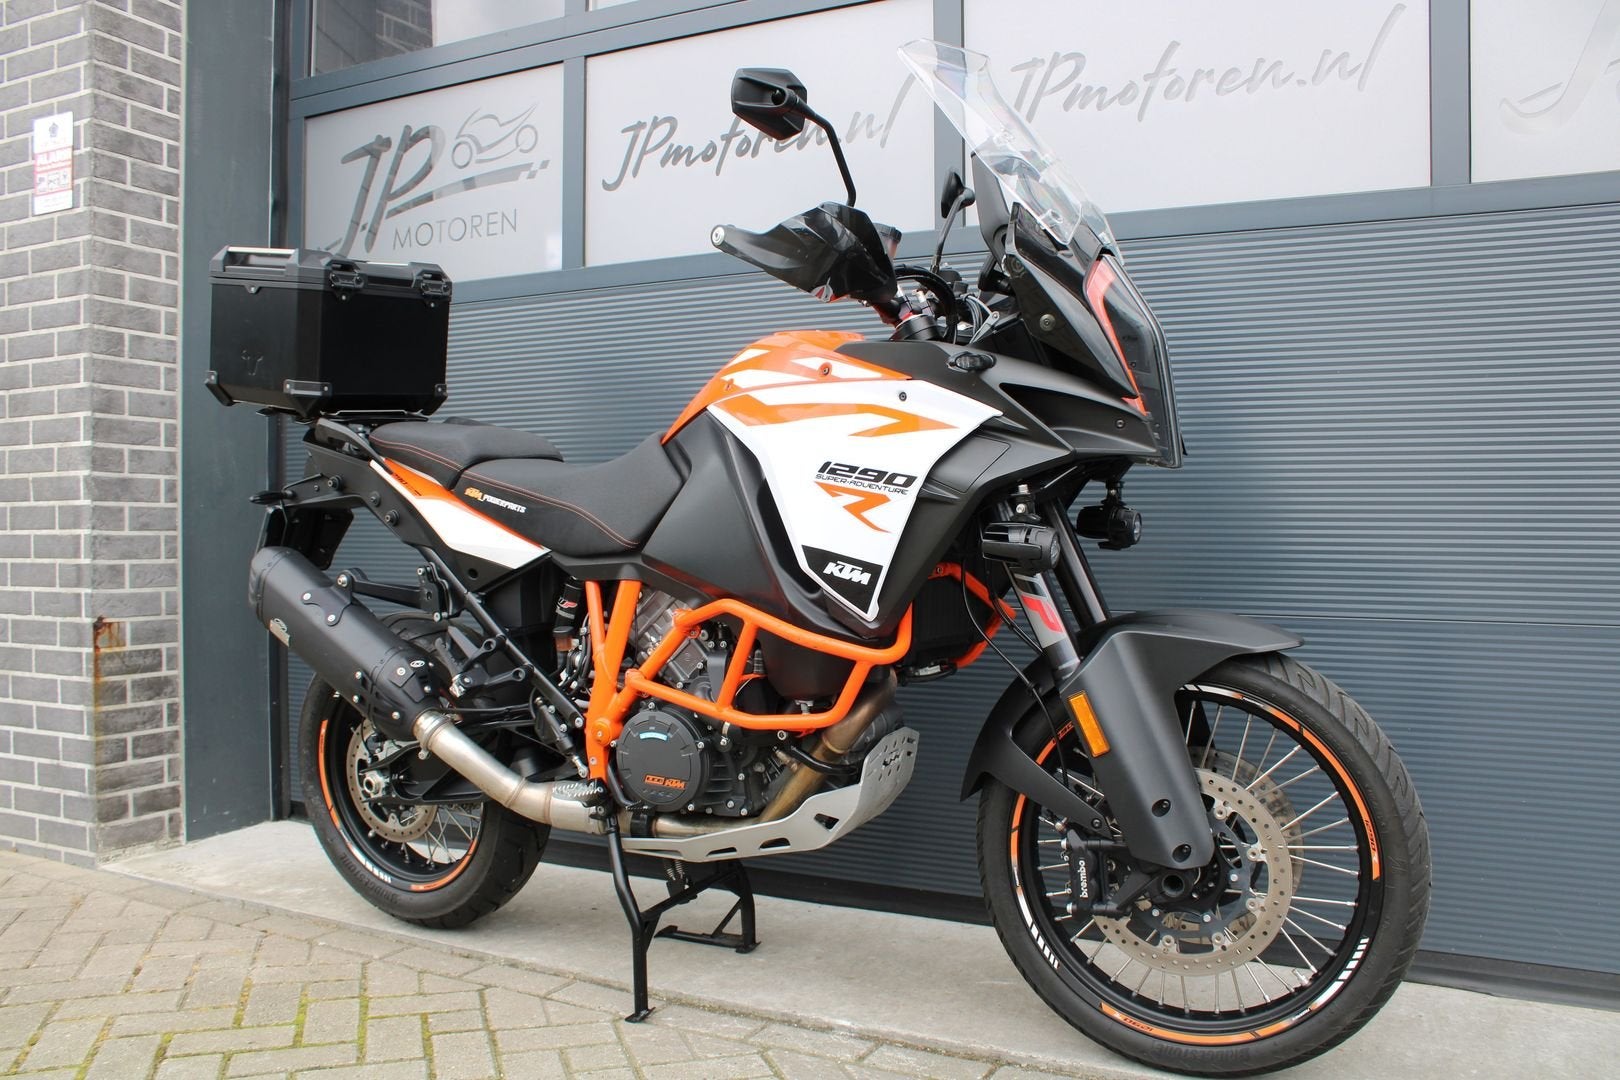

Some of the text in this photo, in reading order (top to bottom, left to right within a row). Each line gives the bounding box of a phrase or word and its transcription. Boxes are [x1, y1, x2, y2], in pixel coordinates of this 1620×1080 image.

[393, 208, 517, 250] MOTOREN
[815, 473, 909, 495] SUPER-ADVENTURE
[817, 461, 918, 488] 1290
[822, 560, 872, 585] KTM
[1077, 860, 1089, 898] brembo
